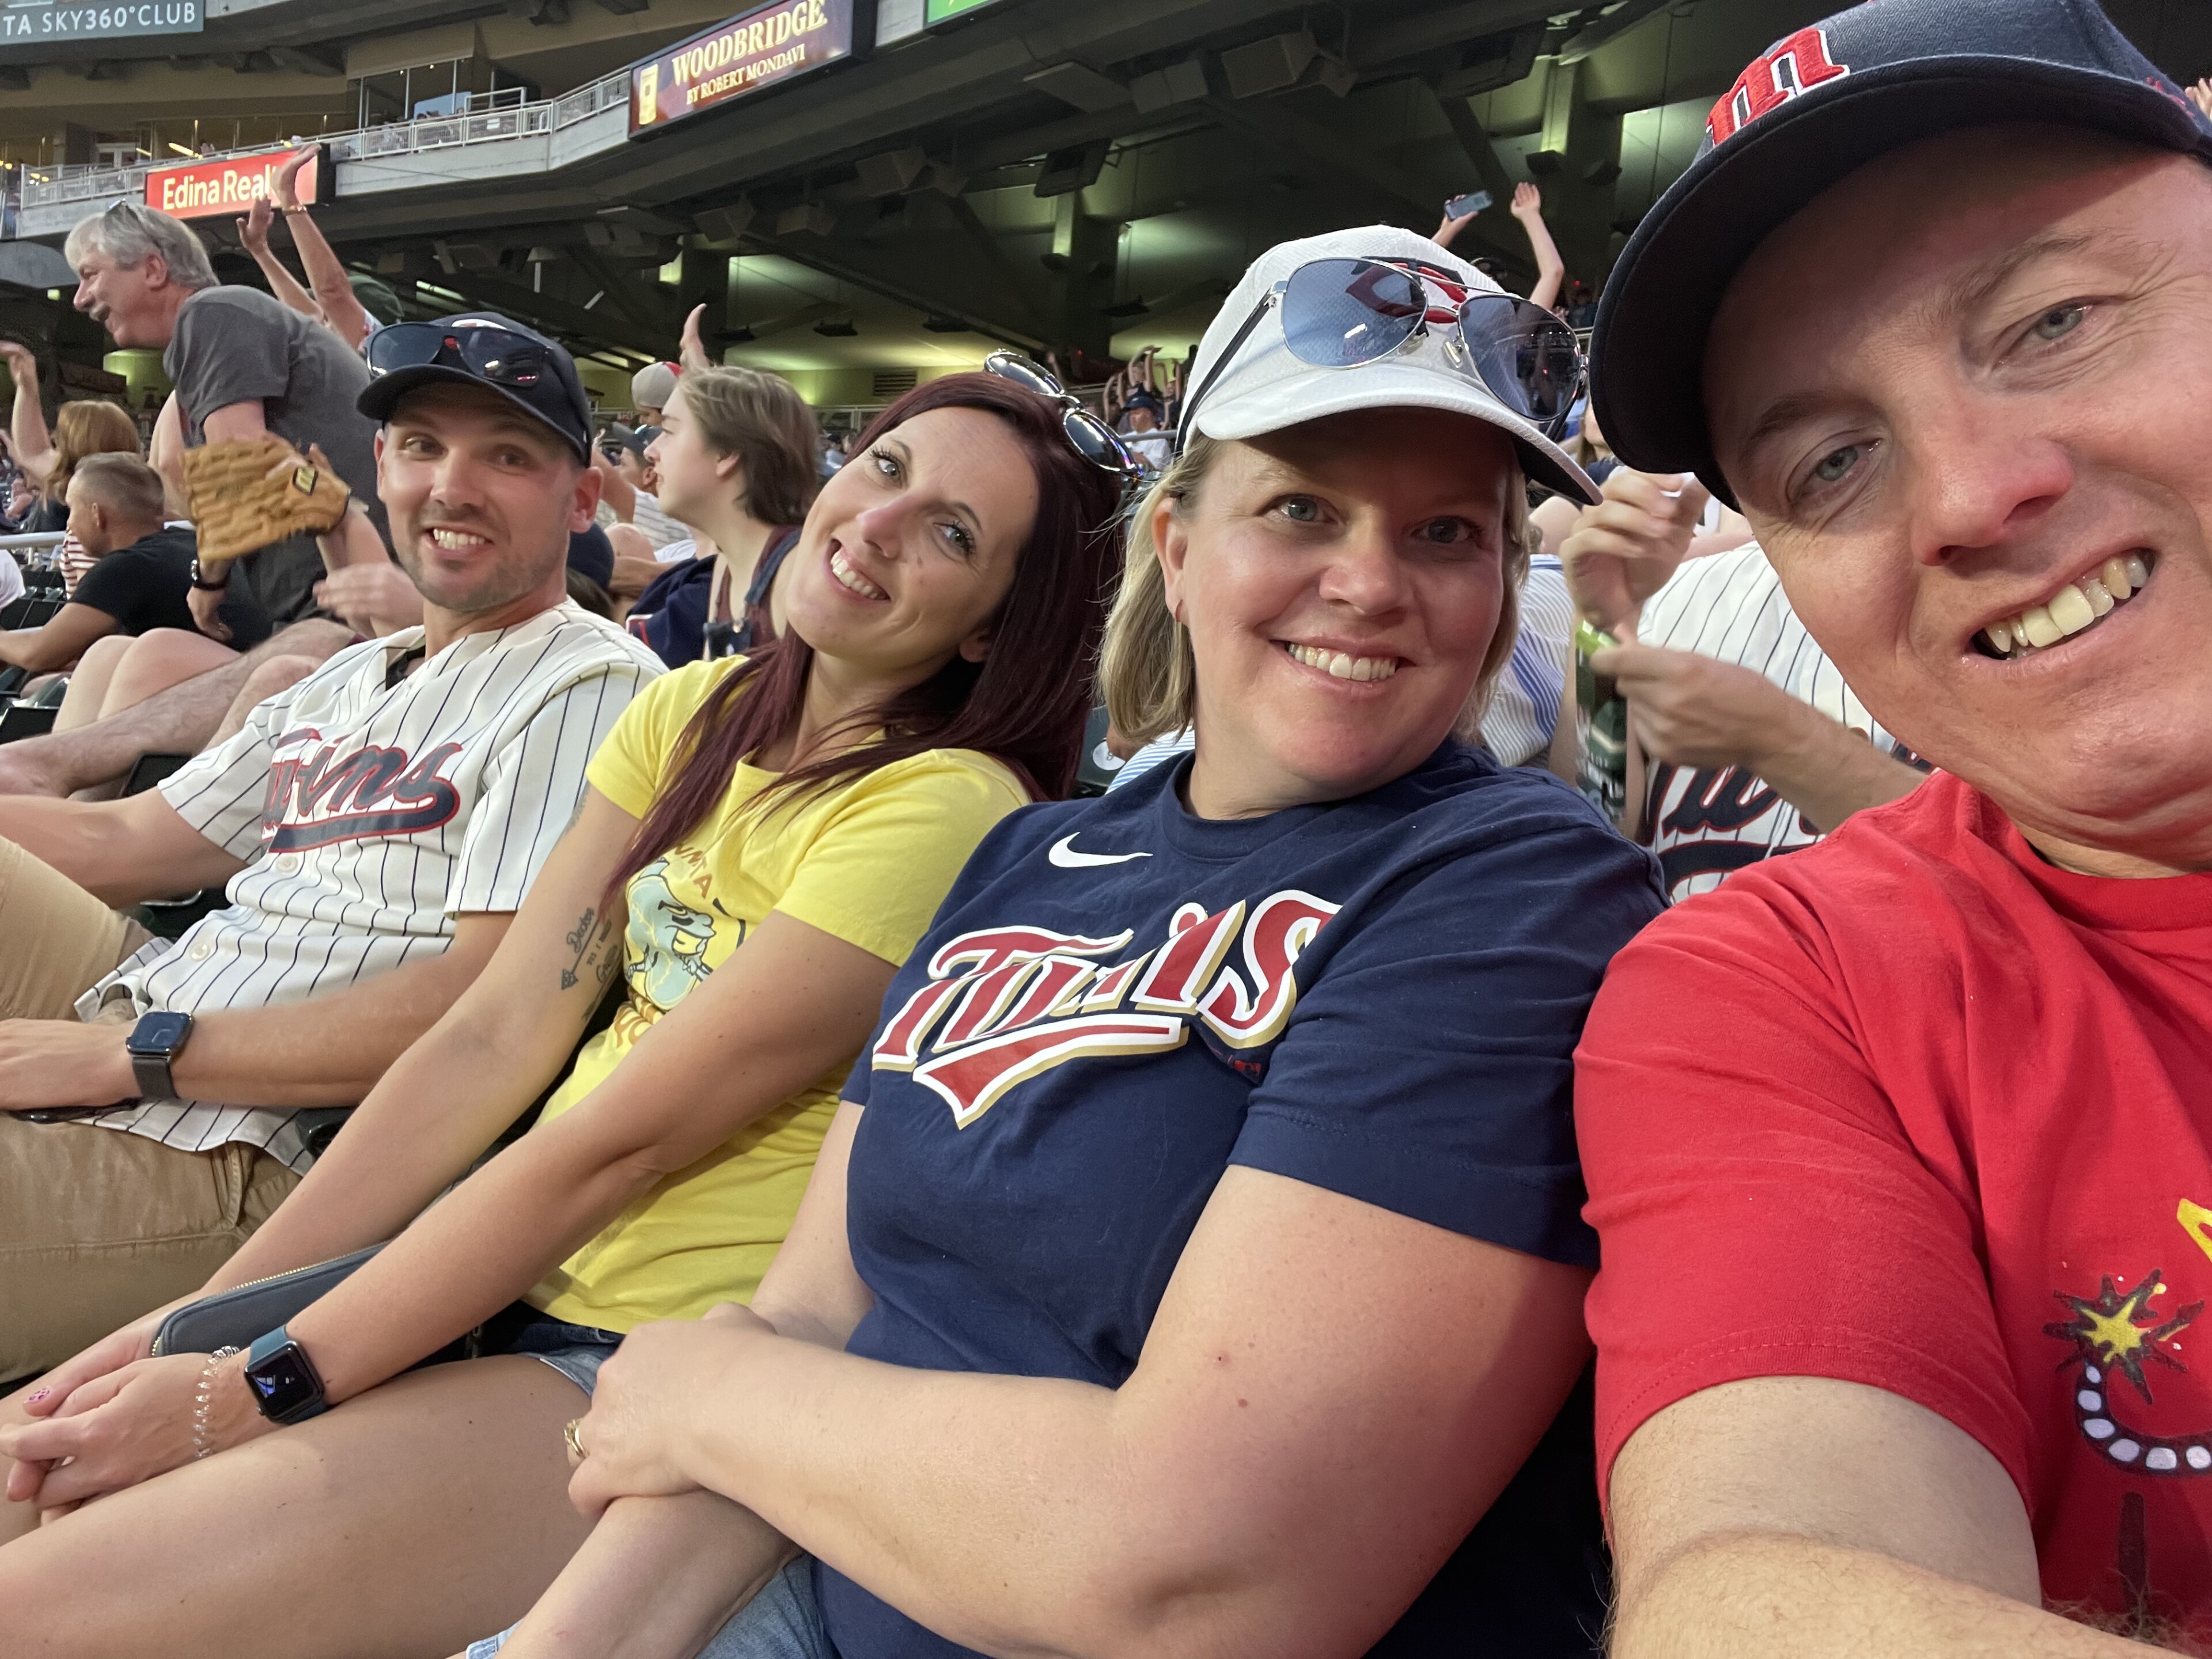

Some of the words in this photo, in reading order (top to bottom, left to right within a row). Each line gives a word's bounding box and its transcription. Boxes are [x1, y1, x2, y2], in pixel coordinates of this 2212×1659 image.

[3, 14, 32, 36] TA
[672, 0, 828, 86] WOODBRIDGE
[686, 85, 701, 105] BY
[700, 69, 747, 99] ROBERT
[746, 43, 806, 82] MONDAVI
[163, 175, 220, 210] Edina
